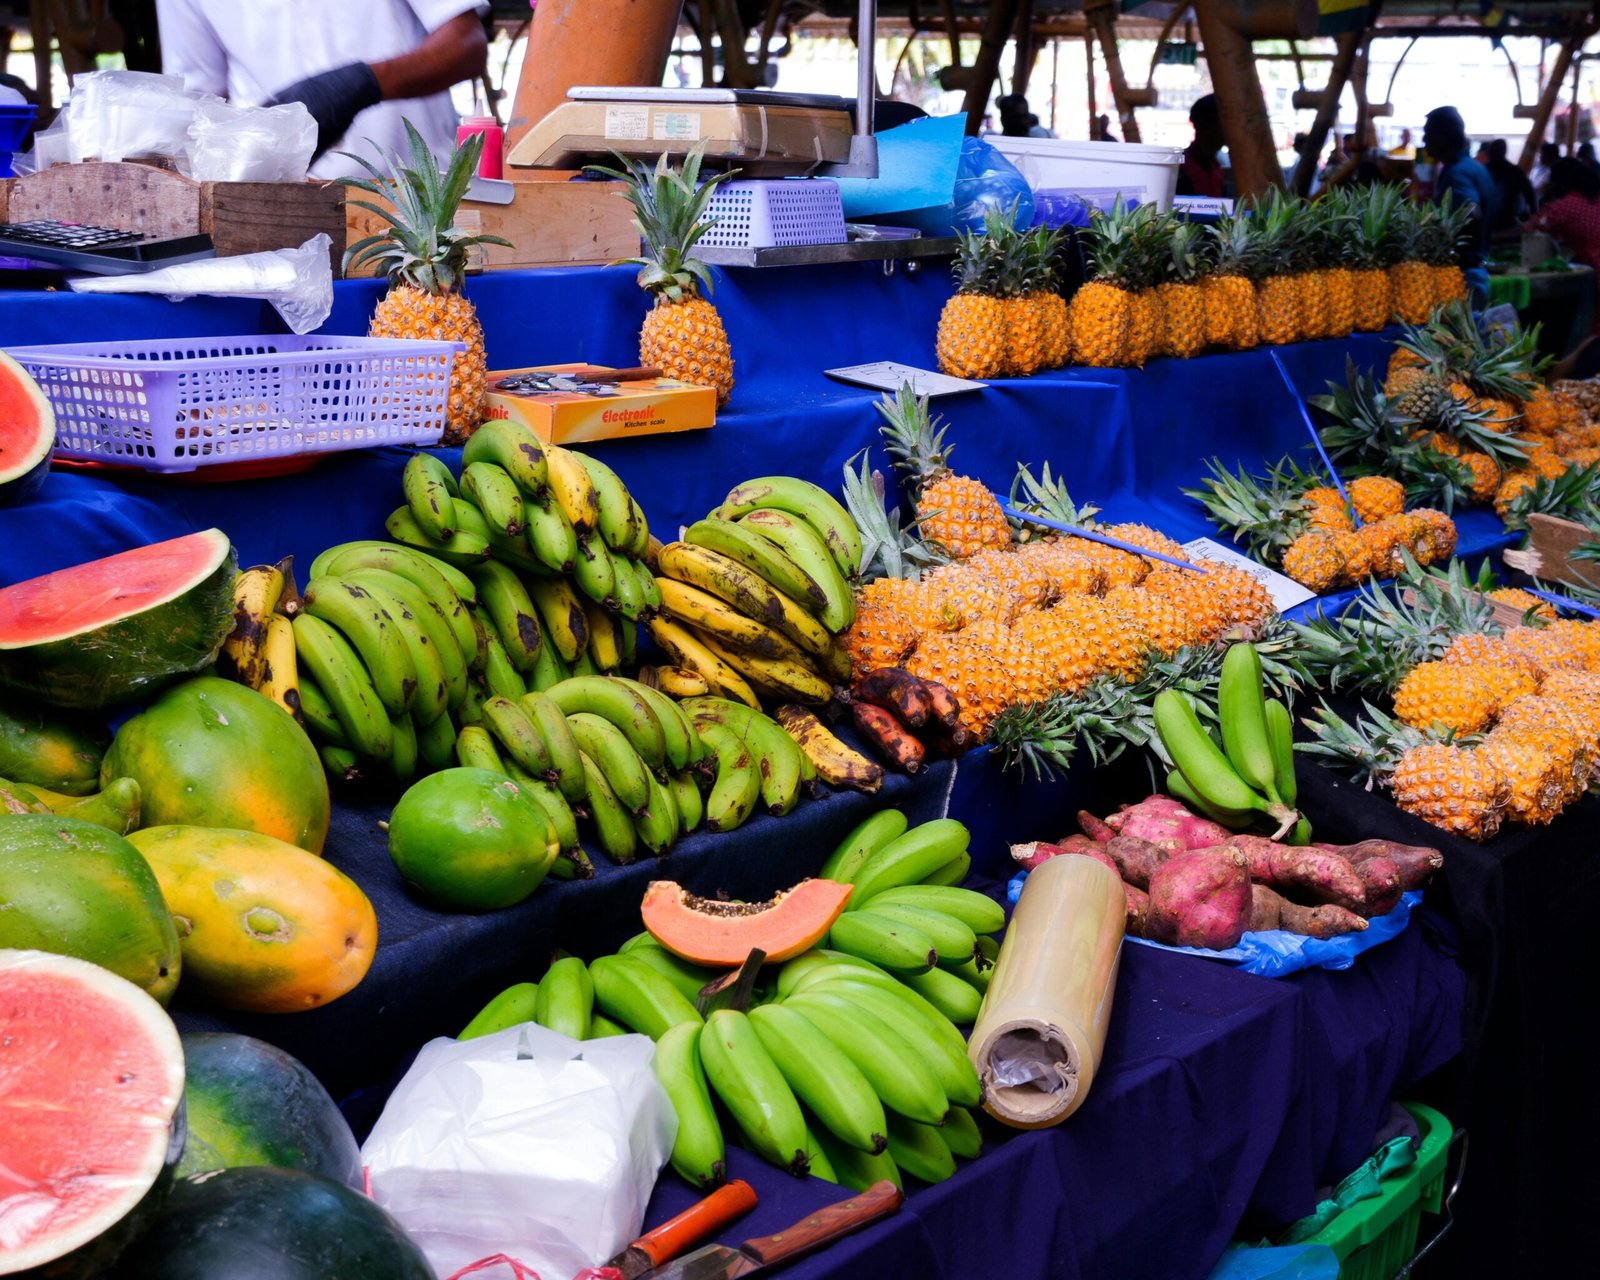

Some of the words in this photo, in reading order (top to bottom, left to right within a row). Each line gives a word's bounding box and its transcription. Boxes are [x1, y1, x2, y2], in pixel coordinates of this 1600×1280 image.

[602, 405, 655, 423] Electronic
[624, 420, 647, 429] Kitchen
[650, 418, 665, 426] scale
